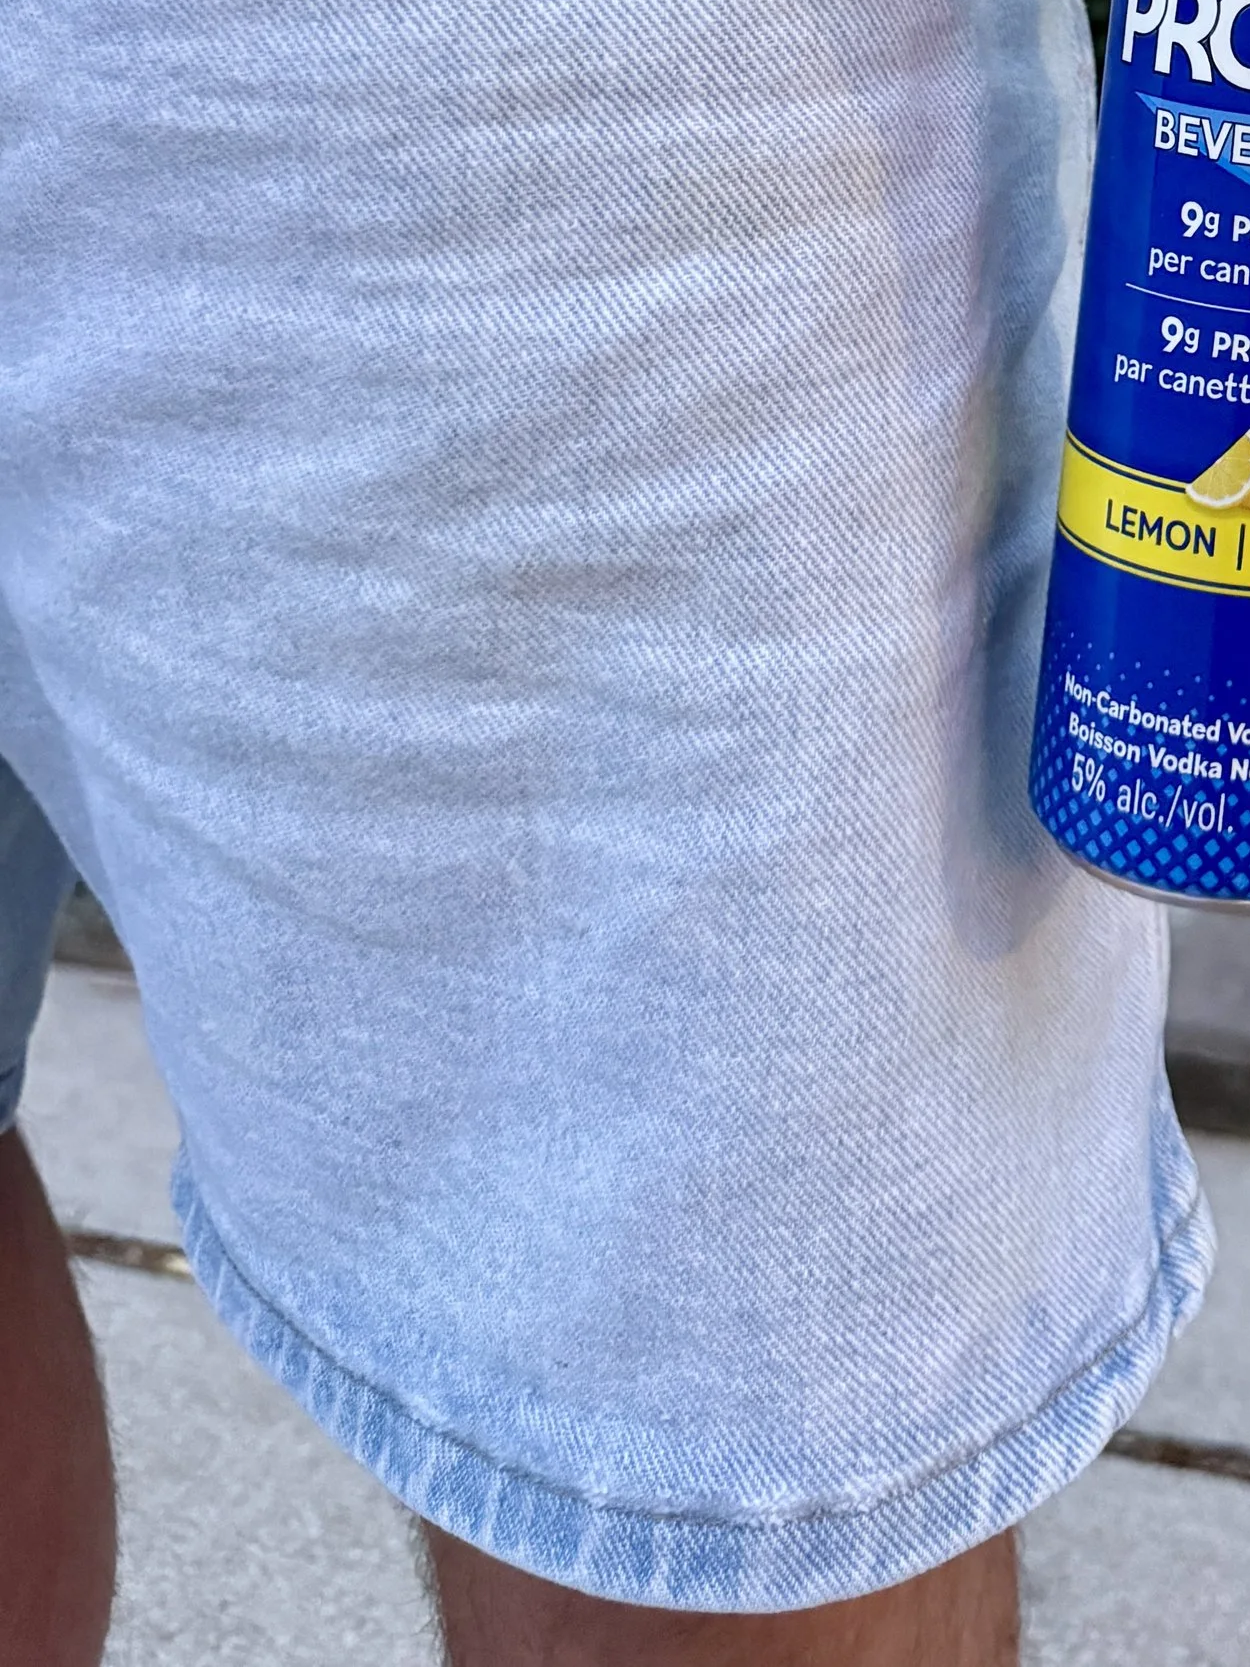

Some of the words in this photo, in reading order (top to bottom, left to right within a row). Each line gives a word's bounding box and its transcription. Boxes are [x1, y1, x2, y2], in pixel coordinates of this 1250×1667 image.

[1180, 200, 1220, 239] 9g
[1148, 246, 1194, 277] per
[1200, 258, 1250, 286] can
[1160, 315, 1200, 354] 9g
[1113, 353, 1153, 383] par
[1105, 498, 1217, 558] LEMON
[1064, 670, 1222, 743] Non-Carbonated
[1068, 711, 1141, 764] Boisson
[1148, 743, 1223, 779] Vodka
[1071, 752, 1106, 803] 5%
[1116, 778, 1234, 834] alc./vol.
